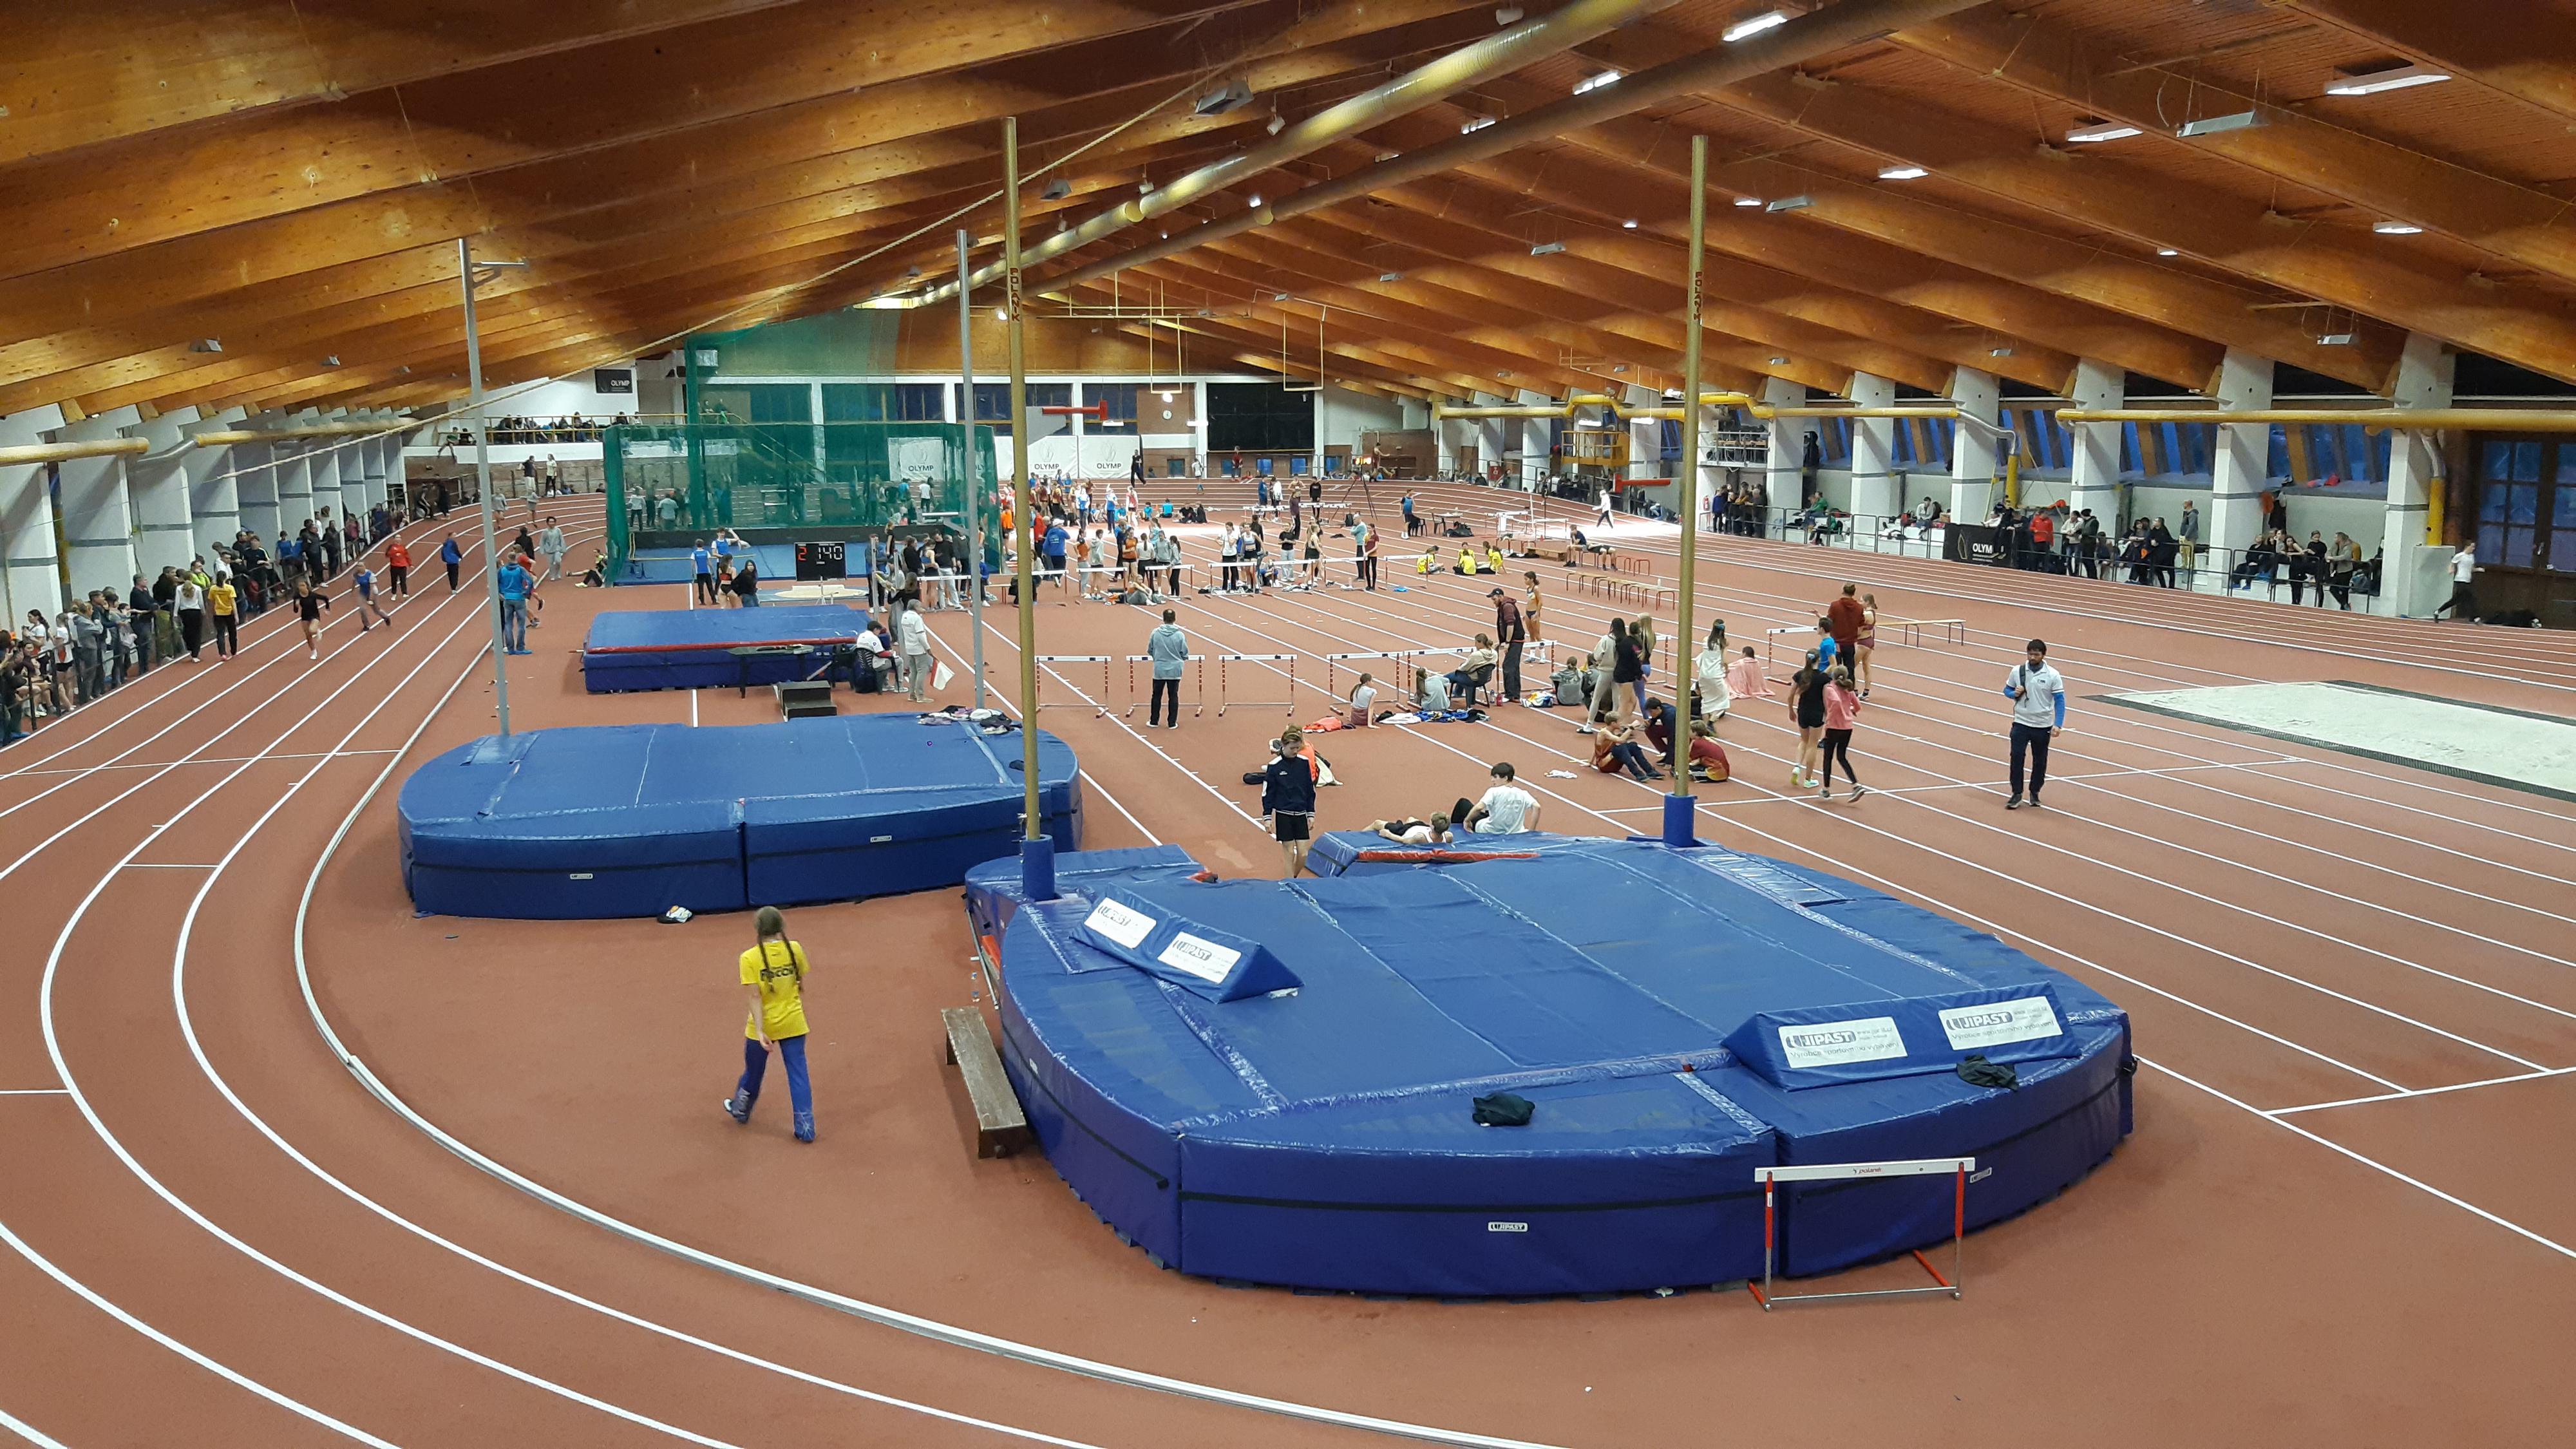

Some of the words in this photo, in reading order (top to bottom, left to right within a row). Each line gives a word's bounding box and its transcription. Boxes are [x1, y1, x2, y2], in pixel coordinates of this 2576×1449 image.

[1010, 267, 1020, 322] POLANIK
[798, 547, 807, 561] 2
[818, 546, 842, 560] 140
[1973, 543, 1993, 553] OLYM
